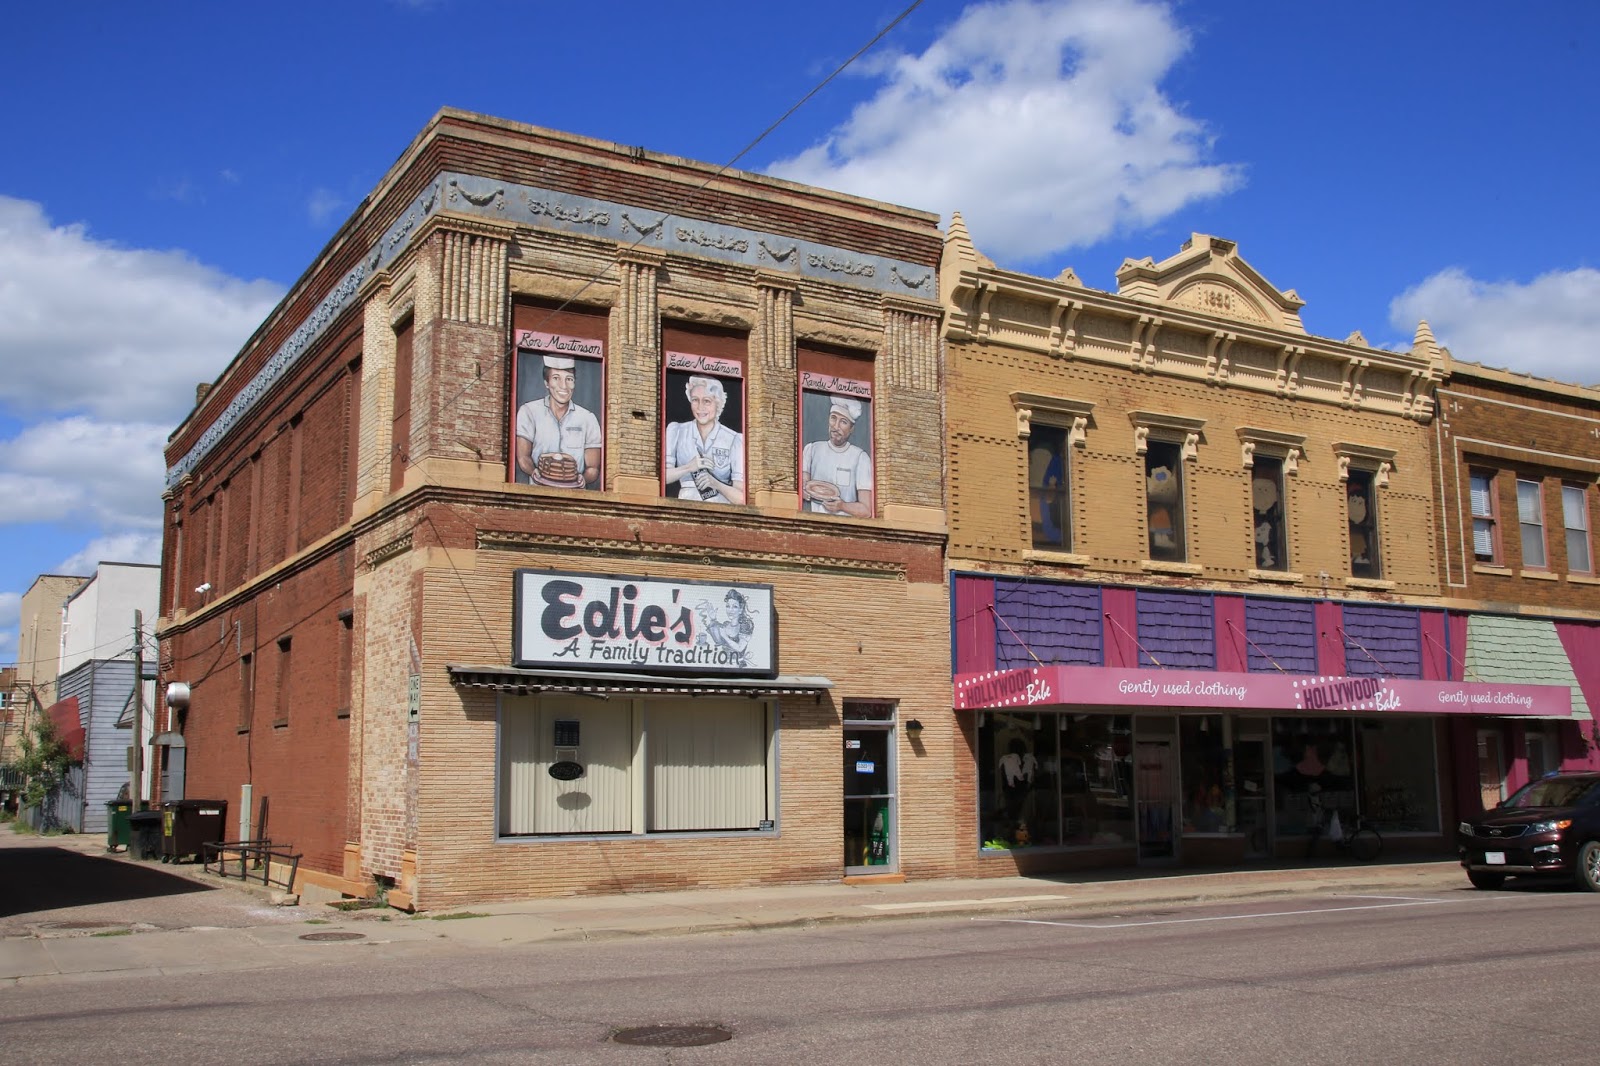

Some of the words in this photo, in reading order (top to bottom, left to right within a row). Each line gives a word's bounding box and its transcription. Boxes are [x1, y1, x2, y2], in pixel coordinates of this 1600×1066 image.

[519, 332, 541, 347] Ron
[546, 335, 601, 355] Martinson
[669, 353, 694, 367] Edie
[693, 356, 739, 375] Martinson
[802, 372, 827, 389] Randy
[828, 377, 870, 395] Martinson
[541, 580, 693, 644] Edie's
[553, 638, 580, 658] A
[590, 640, 650, 665] Family
[656, 641, 742, 665] tradition
[966, 669, 1032, 708] HOLLYWOOD
[1026, 679, 1051, 705] Babe
[1118, 679, 1160, 698] Gently
[1163, 681, 1194, 695] used
[1194, 681, 1248, 700] clothing
[1302, 677, 1380, 710] HOLLYWOOD
[1374, 689, 1401, 711] Babe
[1438, 690, 1469, 706] Gently
[1470, 691, 1494, 704] used
[1493, 691, 1533, 709] clothing
